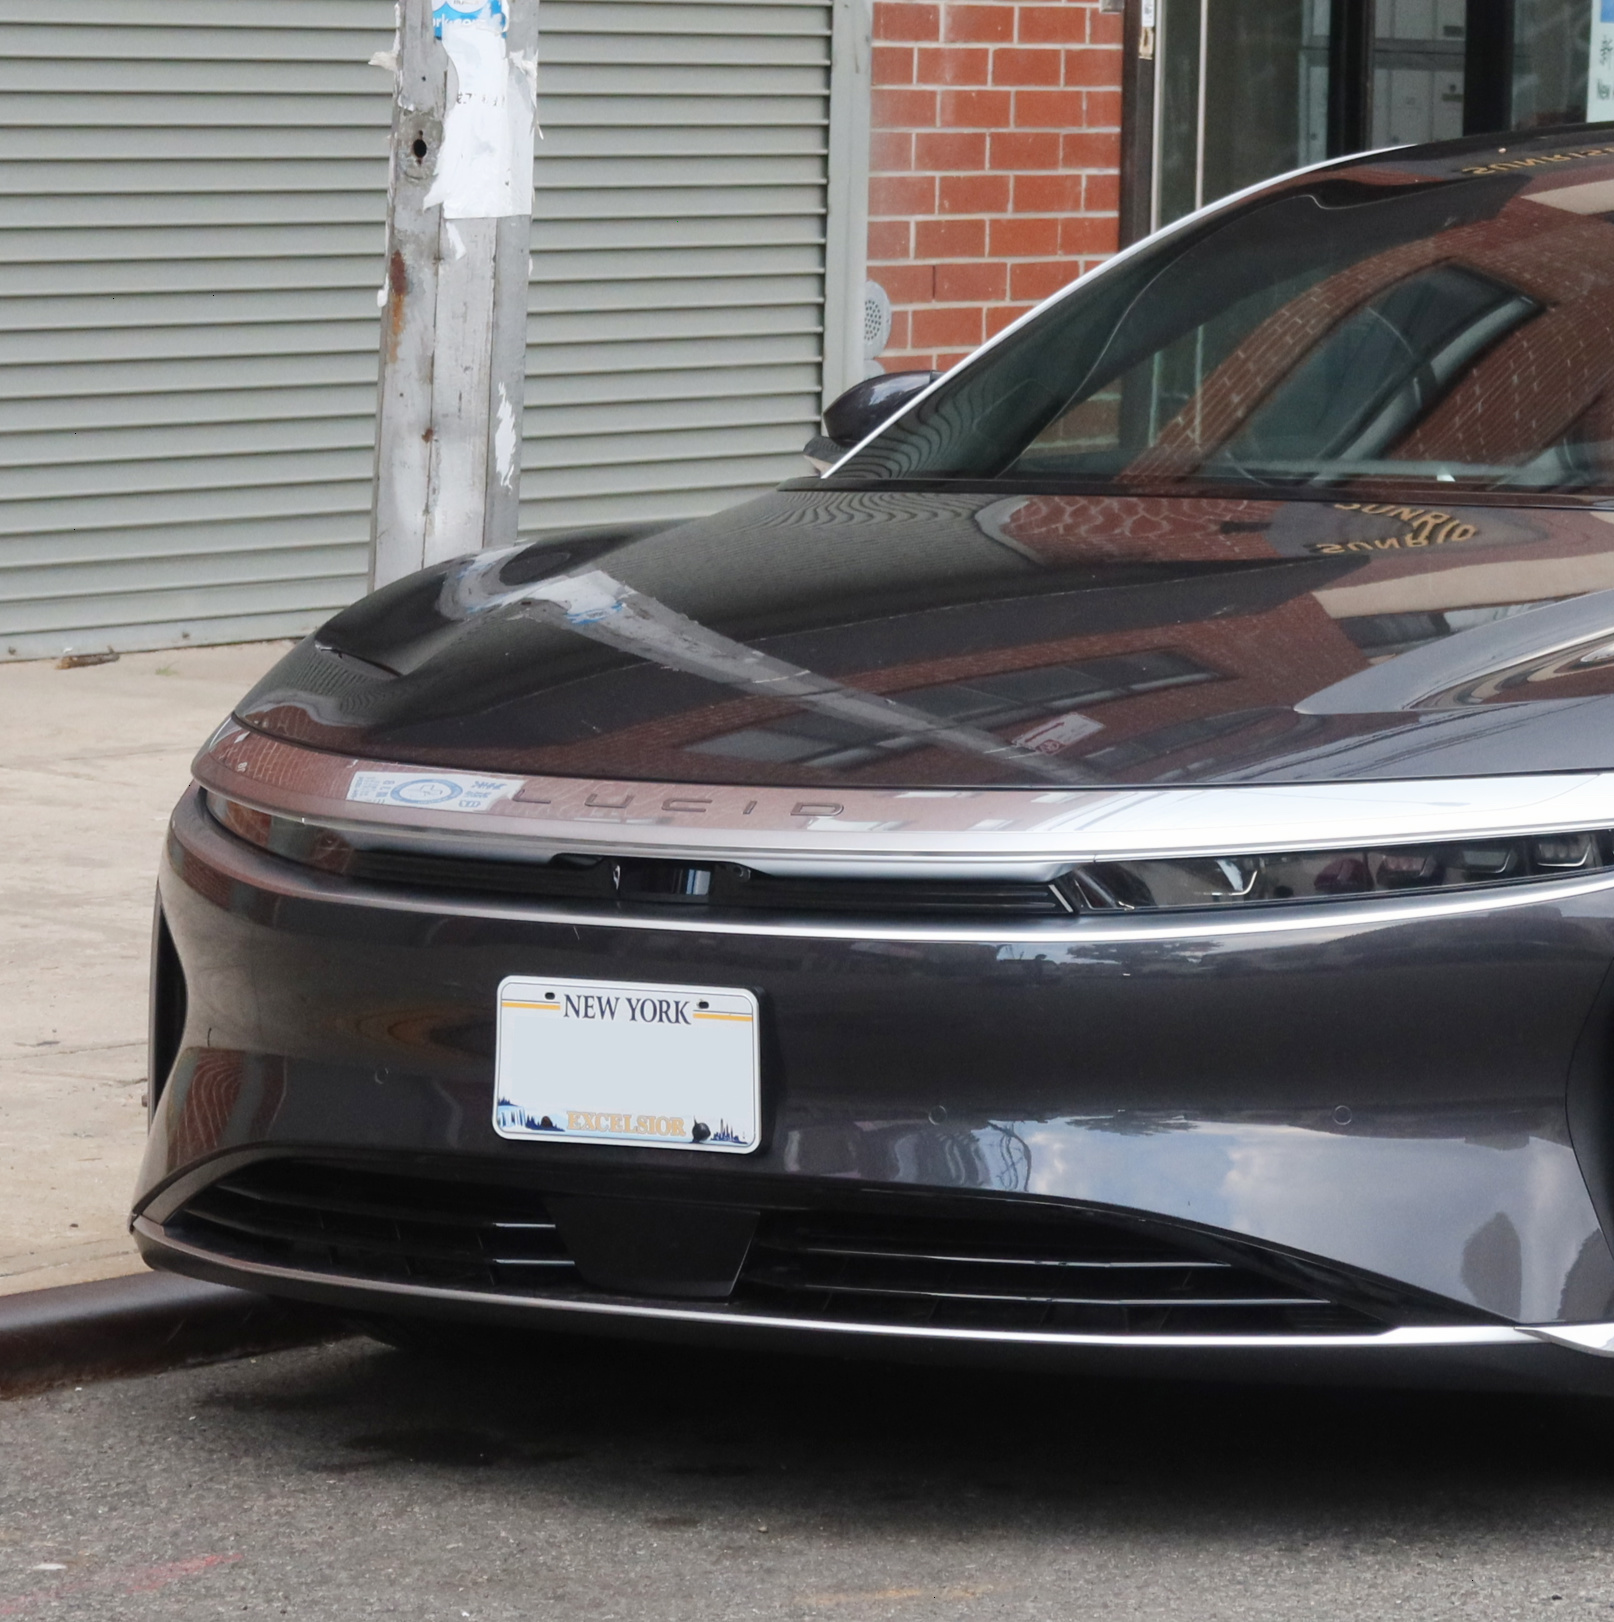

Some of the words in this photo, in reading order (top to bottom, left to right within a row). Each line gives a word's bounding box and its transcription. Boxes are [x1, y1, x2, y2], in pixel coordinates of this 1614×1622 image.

[1598, 79, 1610, 100] New
[512, 788, 844, 816] LUCID
[564, 994, 620, 1020] NEW
[625, 997, 692, 1025] YORK
[566, 1110, 686, 1136] EXCELSIOR
